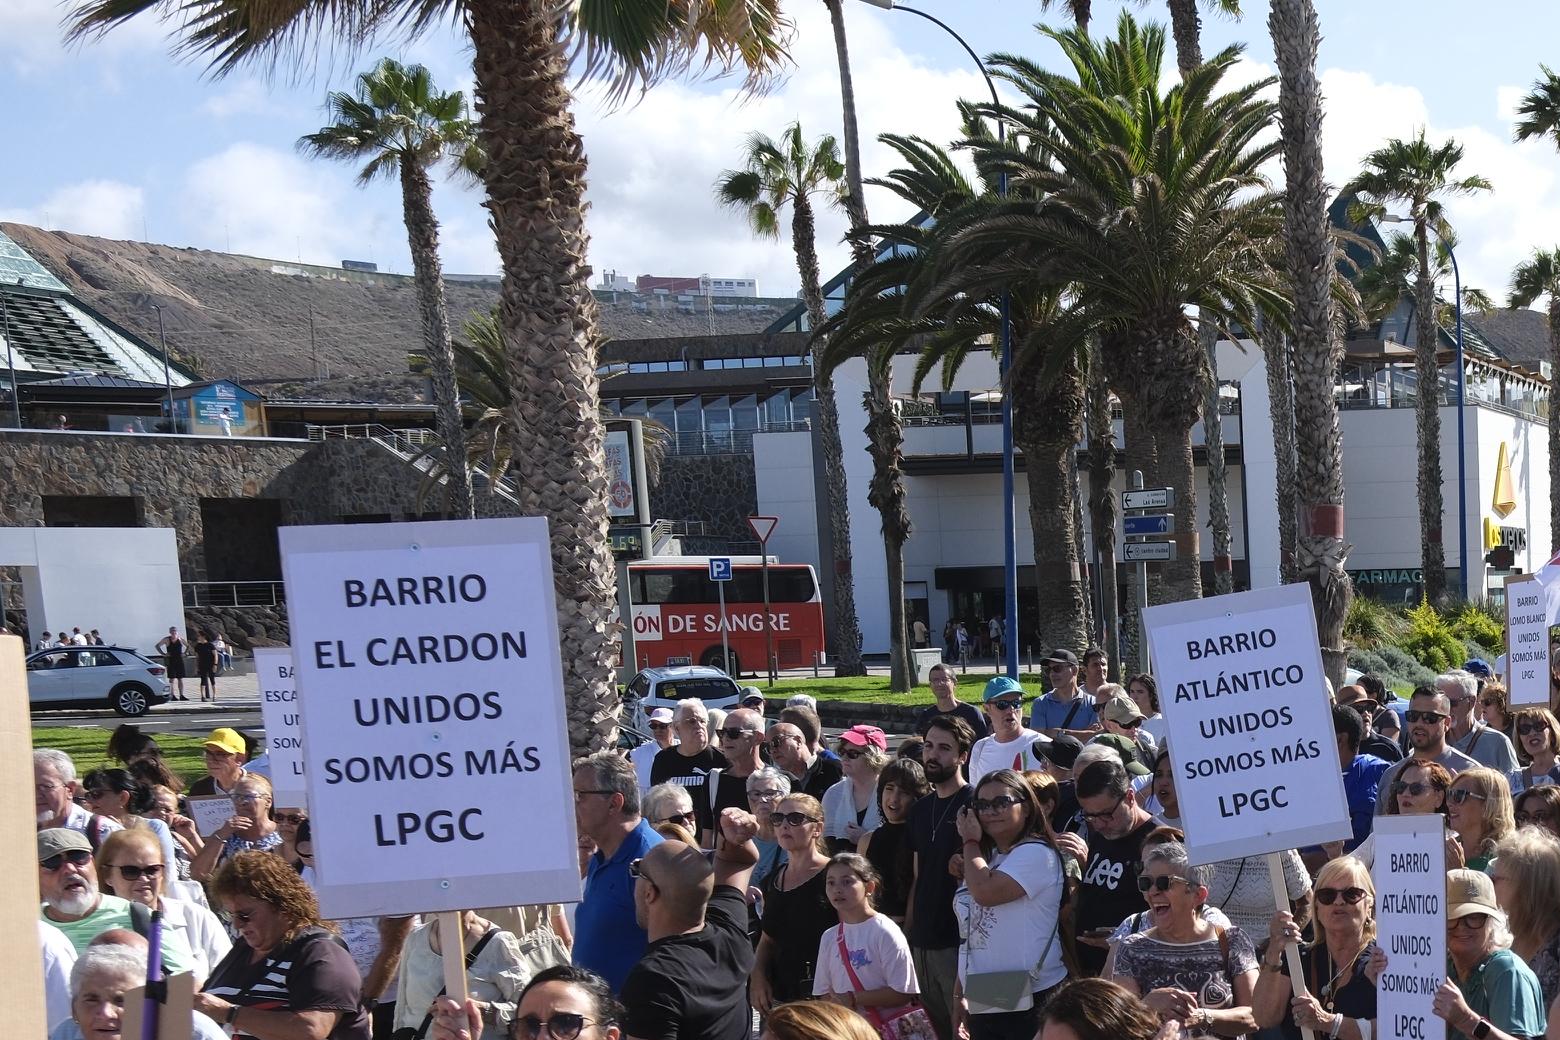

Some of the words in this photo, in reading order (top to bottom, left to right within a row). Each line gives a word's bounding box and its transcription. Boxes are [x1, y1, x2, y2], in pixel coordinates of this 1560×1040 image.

[712, 561, 724, 577] P
[344, 573, 487, 608] BARRIO
[1517, 596, 1538, 606] BARRIO
[669, 614, 698, 633] DE
[704, 613, 790, 632] SANGRE
[1527, 614, 1546, 623] BLANCO
[314, 640, 356, 670] EL
[366, 630, 527, 667] CARDON
[1186, 628, 1277, 661] BARRIO
[1518, 632, 1539, 643] UNIDOS
[1512, 653, 1532, 663] SOMOS
[1534, 650, 1546, 661] MÁS
[1174, 664, 1304, 704] ATLÁNTICO
[1522, 670, 1534, 679] LPGC
[353, 691, 503, 727] UNIDOS
[1199, 706, 1293, 739] UNIDOS
[324, 751, 454, 785] SOMOS
[464, 740, 541, 776] MÁS
[1184, 750, 1266, 780] SOMOS
[1271, 738, 1321, 765] MÁS
[1218, 785, 1289, 818] LPGC
[374, 807, 485, 847] LPGC
[1083, 852, 1123, 890] Lee
[1390, 852, 1430, 873] BARRIO
[1381, 888, 1439, 915] ATLÁNTICO
[1391, 934, 1432, 957] UNIDOS
[1381, 973, 1419, 994] SOMOS
[1417, 969, 1440, 995] MÁS
[1394, 1014, 1425, 1040] LPGC
